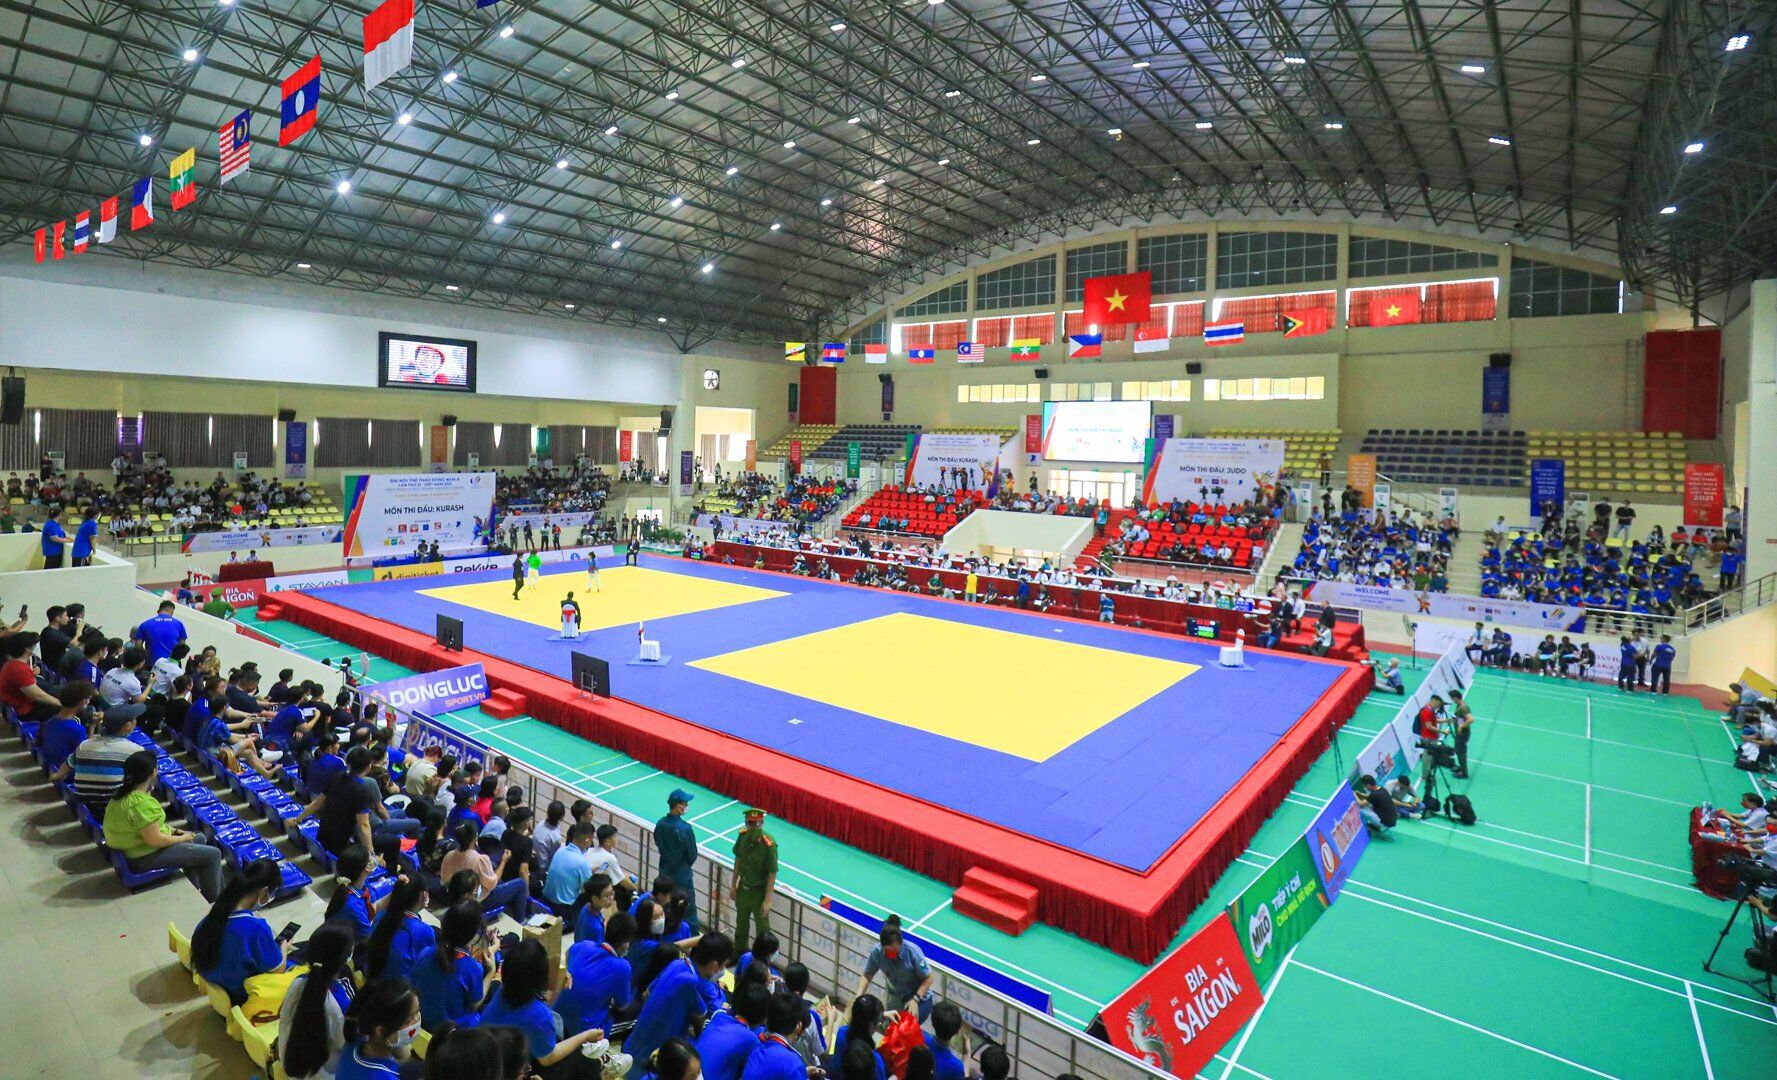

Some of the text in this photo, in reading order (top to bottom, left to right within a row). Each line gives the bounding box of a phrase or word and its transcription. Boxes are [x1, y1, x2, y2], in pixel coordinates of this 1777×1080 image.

[384, 506, 402, 515] MÔN
[417, 504, 434, 513] ĐẤU:
[210, 591, 255, 603] AIGON
[1355, 587, 1390, 596] WELCOME
[389, 674, 483, 707] DONGLUC
[445, 692, 486, 708] SPORT.VN
[1252, 915, 1270, 952] MILO
[1184, 964, 1208, 993] BIA
[1174, 967, 1240, 1045] SAIGON
